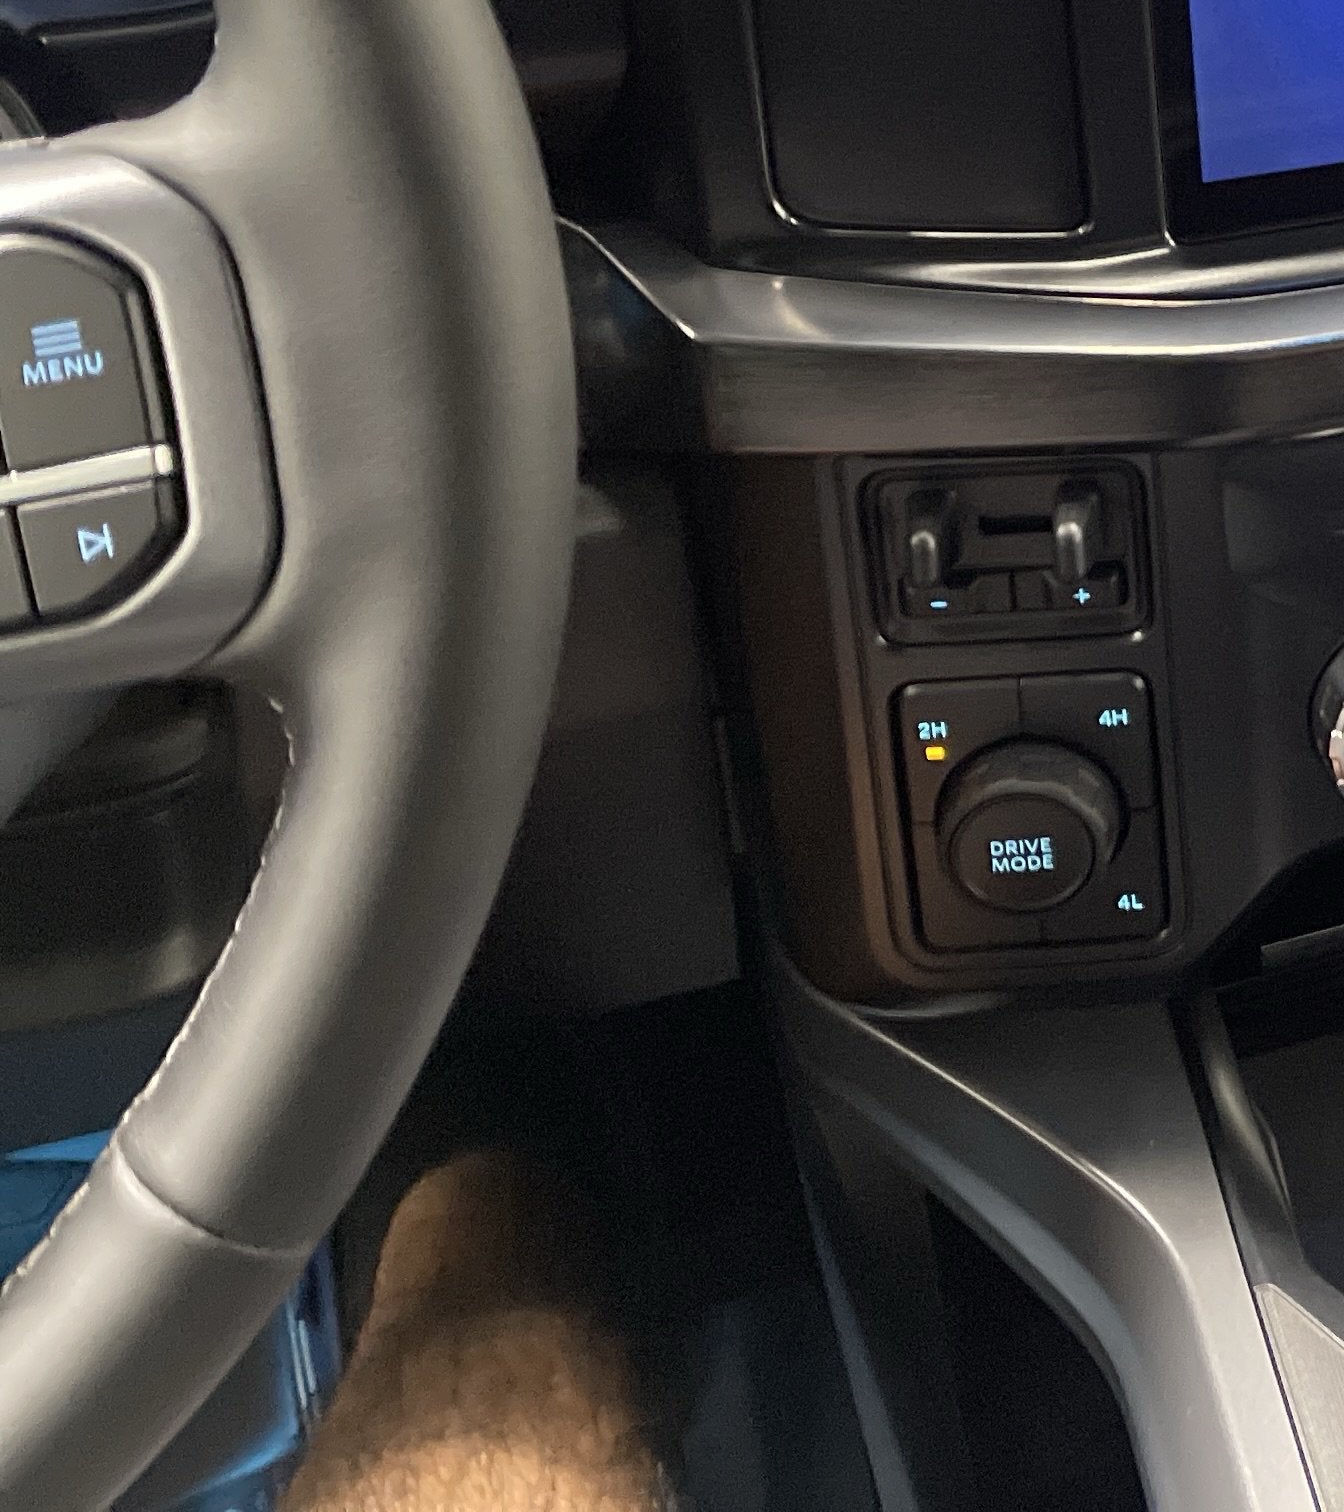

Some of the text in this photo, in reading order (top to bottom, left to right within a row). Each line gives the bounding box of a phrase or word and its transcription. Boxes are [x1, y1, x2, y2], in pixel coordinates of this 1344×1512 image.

[22, 350, 104, 386] MENU
[1098, 708, 1129, 728] 4H
[917, 721, 948, 740] 2H
[990, 836, 1052, 857] DRIVE
[991, 853, 1055, 874] MODE
[1117, 893, 1144, 912] 4L
